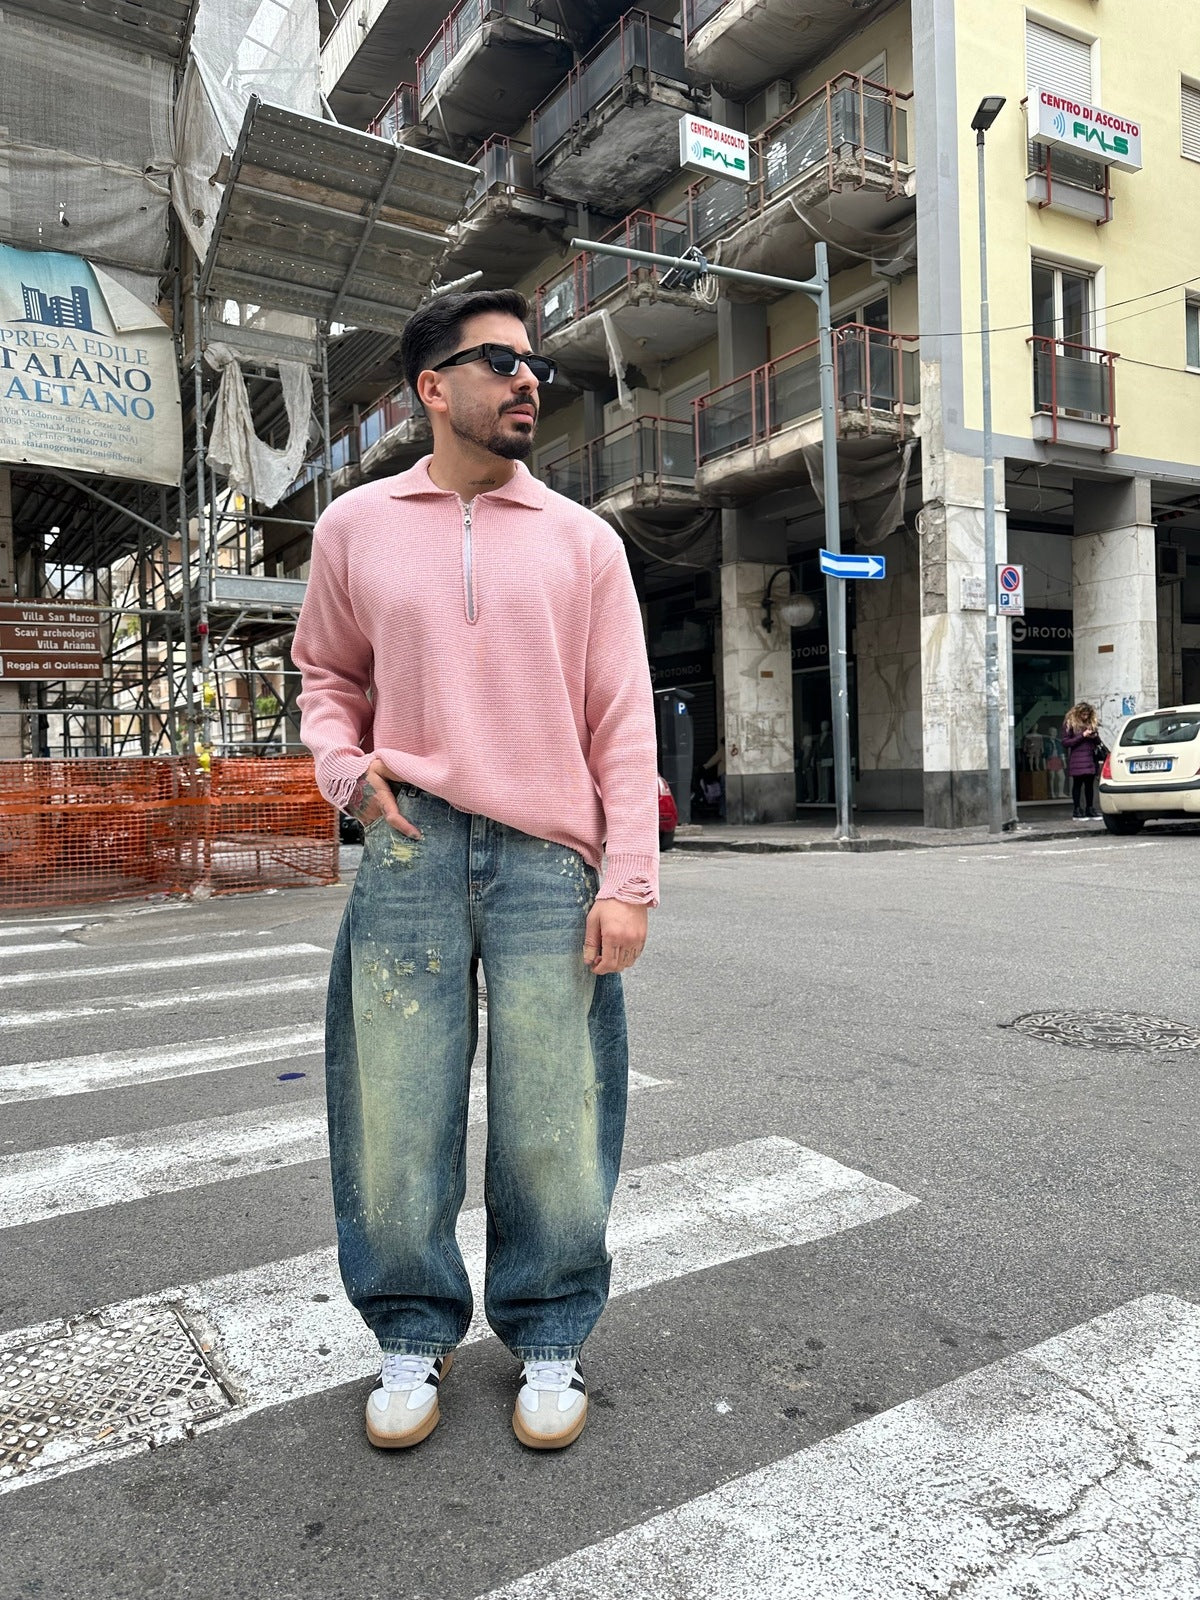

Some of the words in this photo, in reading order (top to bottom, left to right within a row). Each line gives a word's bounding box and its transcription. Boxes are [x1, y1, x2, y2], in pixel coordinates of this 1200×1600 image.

[1040, 92, 1081, 116] CENTRO
[1083, 107, 1093, 120] DI
[1095, 112, 1139, 137] ASCOLTO
[690, 121, 713, 139] CENTRO
[714, 130, 720, 142] DI
[720, 132, 745, 150] ASCOLTO
[82, 337, 149, 366] EDILE
[0, 346, 152, 393] TAIANO
[4, 375, 156, 421] AETANO
[4, 406, 19, 416] Via
[21, 409, 63, 421] Madonna
[64, 414, 86, 424] delle
[118, 423, 131, 432] 268
[29, 419, 55, 430] Santa
[56, 423, 81, 434] Maria
[83, 427, 91, 435] la
[22, 611, 44, 621] Villa
[48, 612, 65, 622] San
[69, 613, 95, 623] Marco
[14, 627, 39, 637] Scavi
[43, 628, 96, 640] archeologici
[37, 640, 59, 650] Villa
[63, 641, 96, 650] Arianna
[7, 661, 40, 671] Reggia
[42, 661, 52, 670] di
[54, 661, 100, 670] Quisisana
